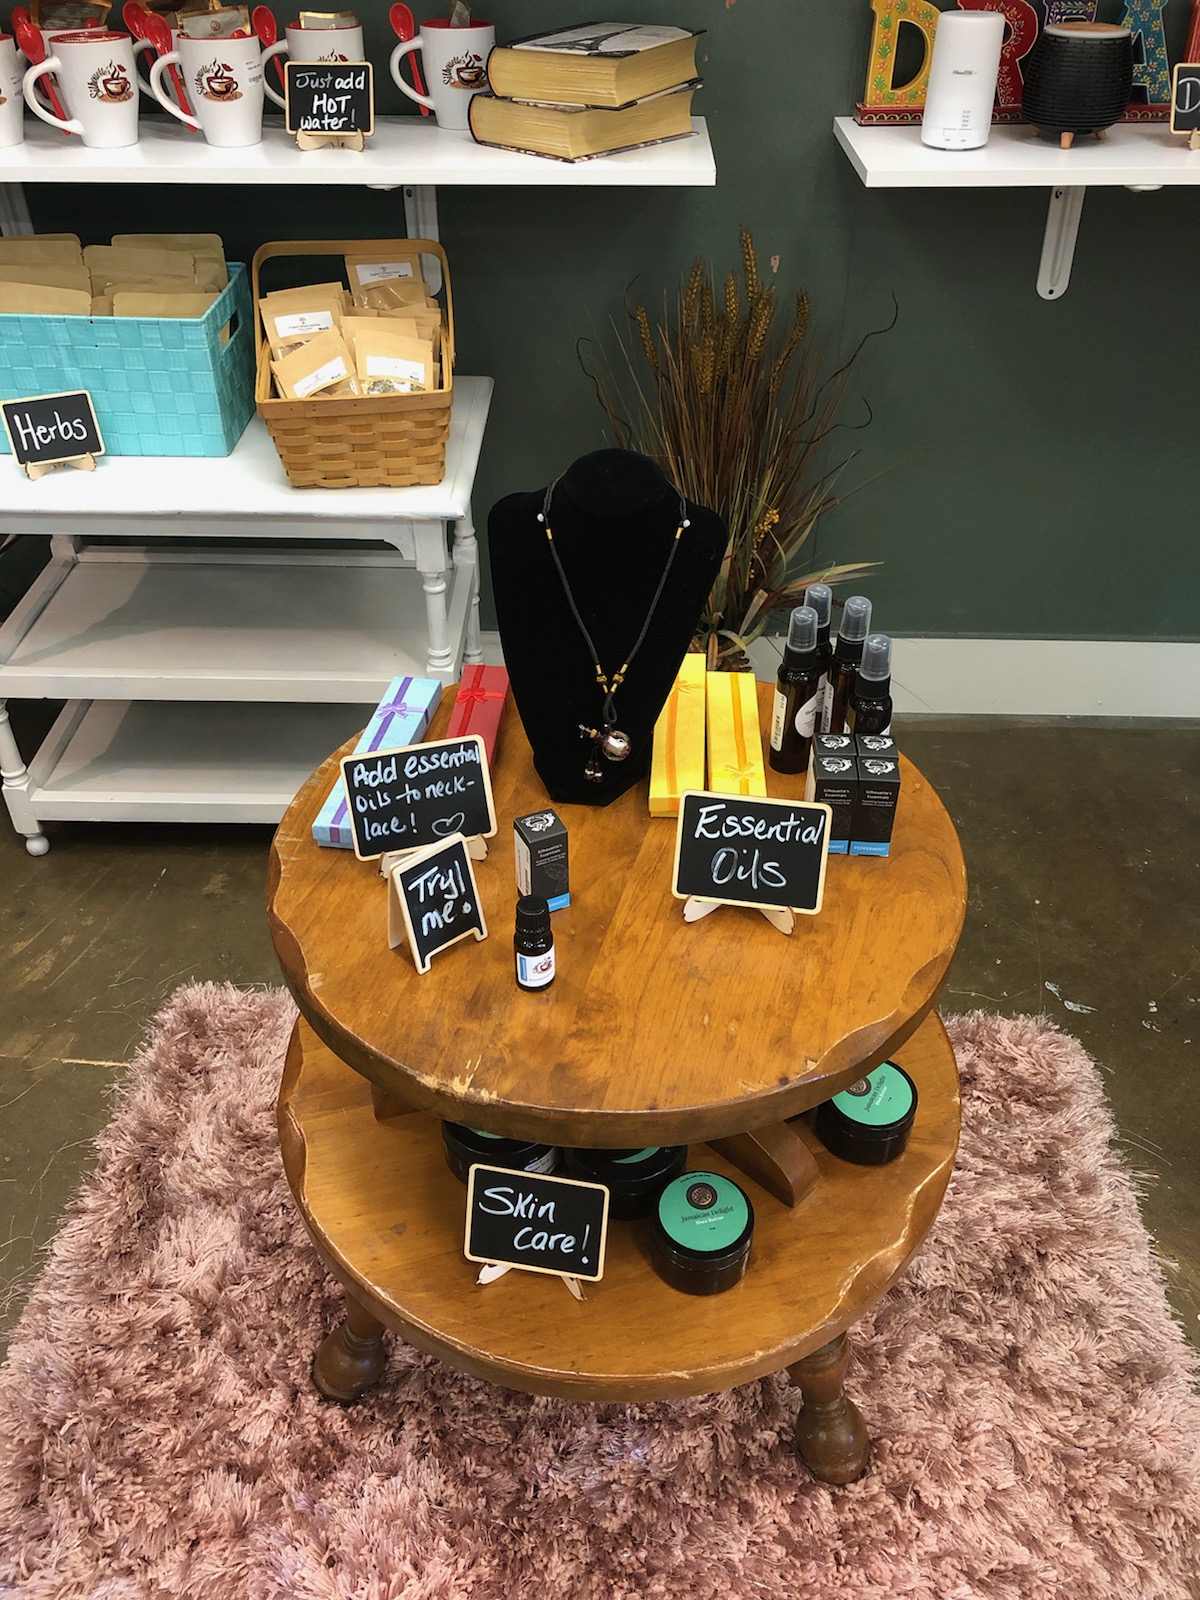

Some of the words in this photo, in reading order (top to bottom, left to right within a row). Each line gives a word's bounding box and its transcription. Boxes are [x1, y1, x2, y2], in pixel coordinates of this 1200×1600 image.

[296, 72, 333, 88] Just
[335, 71, 365, 90] add
[313, 93, 351, 114] HOT
[300, 108, 355, 130] water!
[13, 411, 87, 451] Herbs
[353, 757, 397, 788] Add
[395, 783, 422, 804] to
[363, 812, 418, 842] lace!
[694, 803, 825, 845] Essential
[711, 846, 787, 890] Oils
[478, 1186, 556, 1223] Skin
